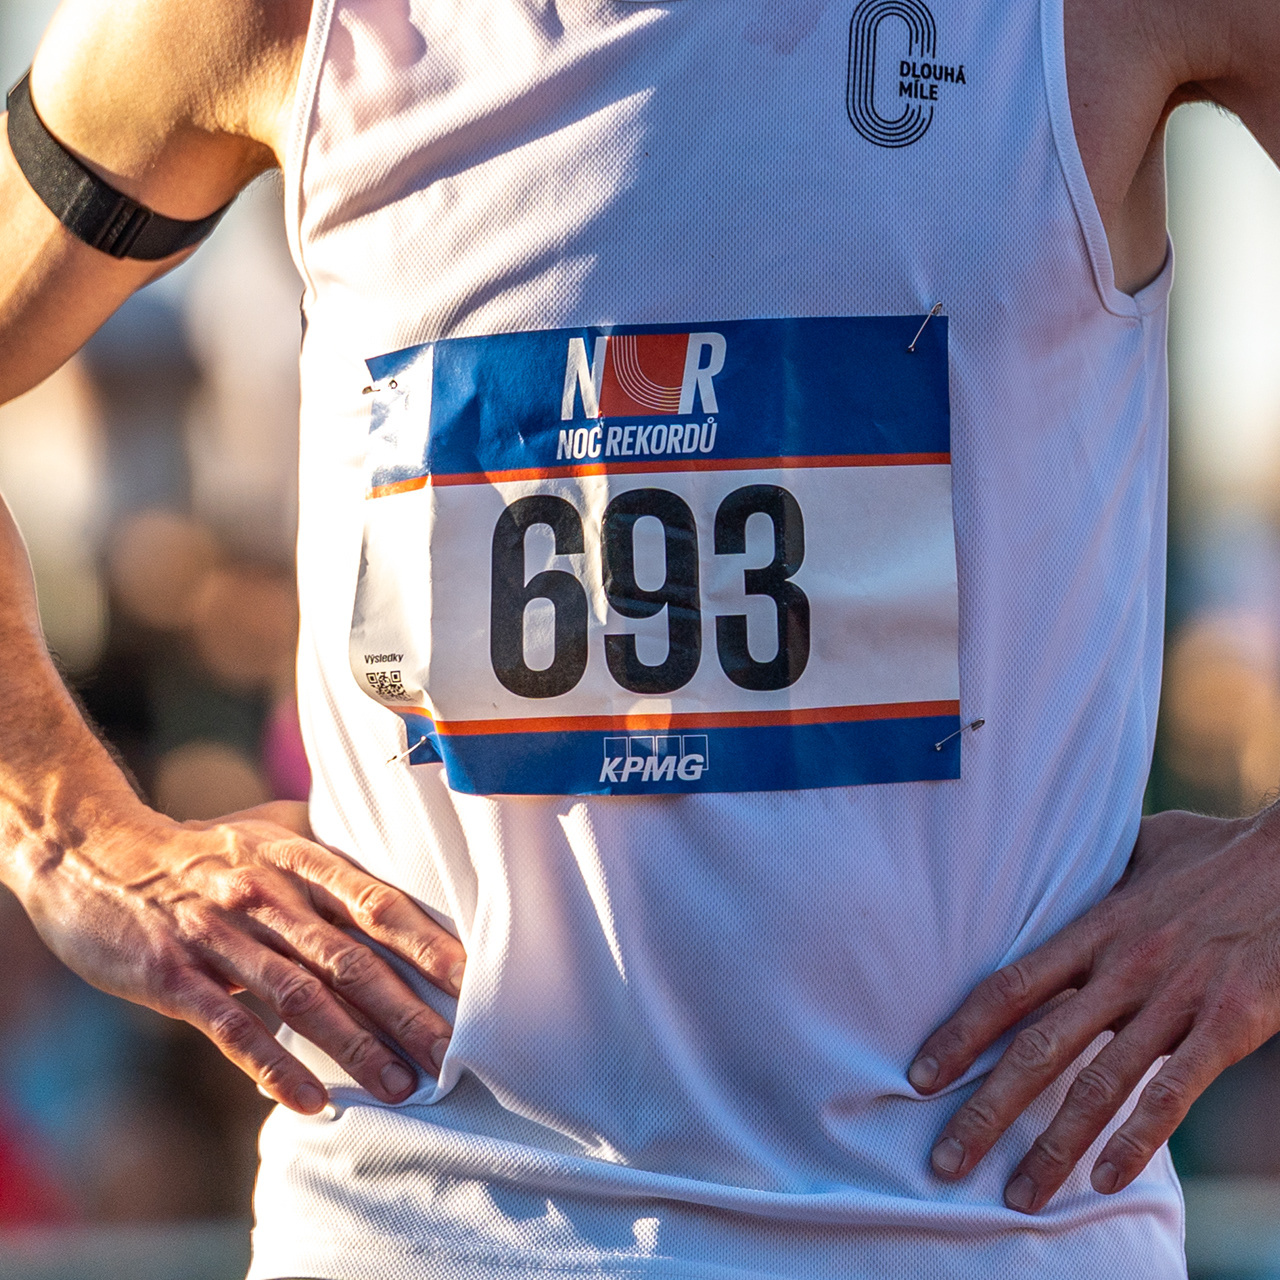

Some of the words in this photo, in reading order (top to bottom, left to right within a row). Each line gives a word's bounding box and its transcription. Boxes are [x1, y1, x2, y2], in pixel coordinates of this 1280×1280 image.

[899, 60, 966, 85] DLOUHÁ
[899, 80, 938, 101] MÍLE
[556, 426, 603, 460] NOC
[605, 416, 718, 457] REKORDŮ
[489, 483, 811, 699] 693
[364, 653, 404, 665] Výsledky
[599, 754, 705, 783] KPMG
